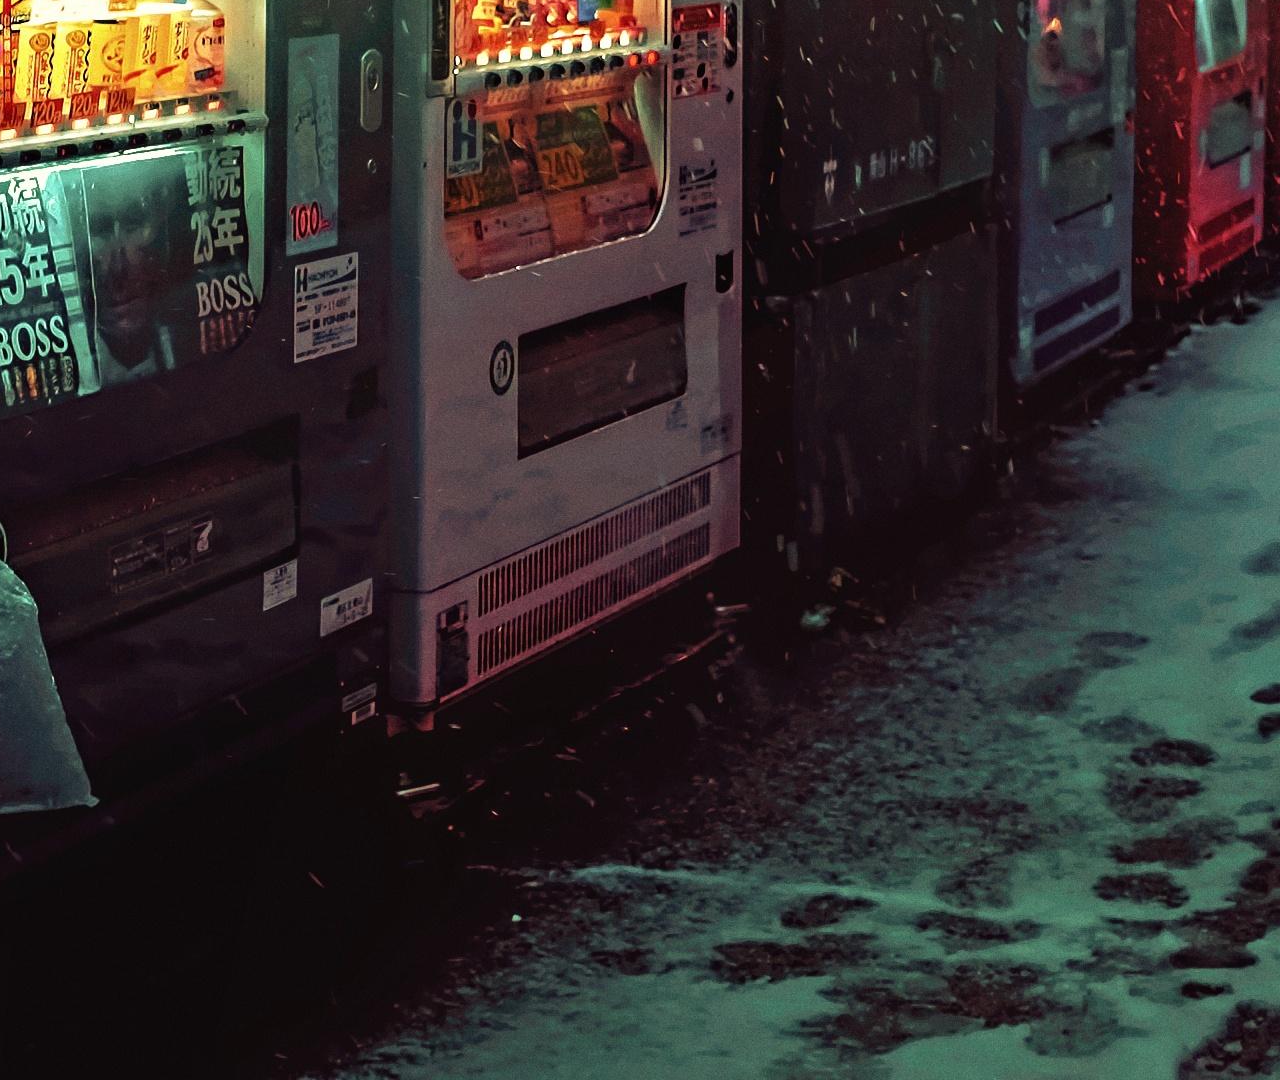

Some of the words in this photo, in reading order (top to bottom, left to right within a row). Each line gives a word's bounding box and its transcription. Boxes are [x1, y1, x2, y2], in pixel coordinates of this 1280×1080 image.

[185, 145, 240, 205] 勤続
[191, 206, 243, 265] 25年
[196, 273, 253, 318] BOSS
